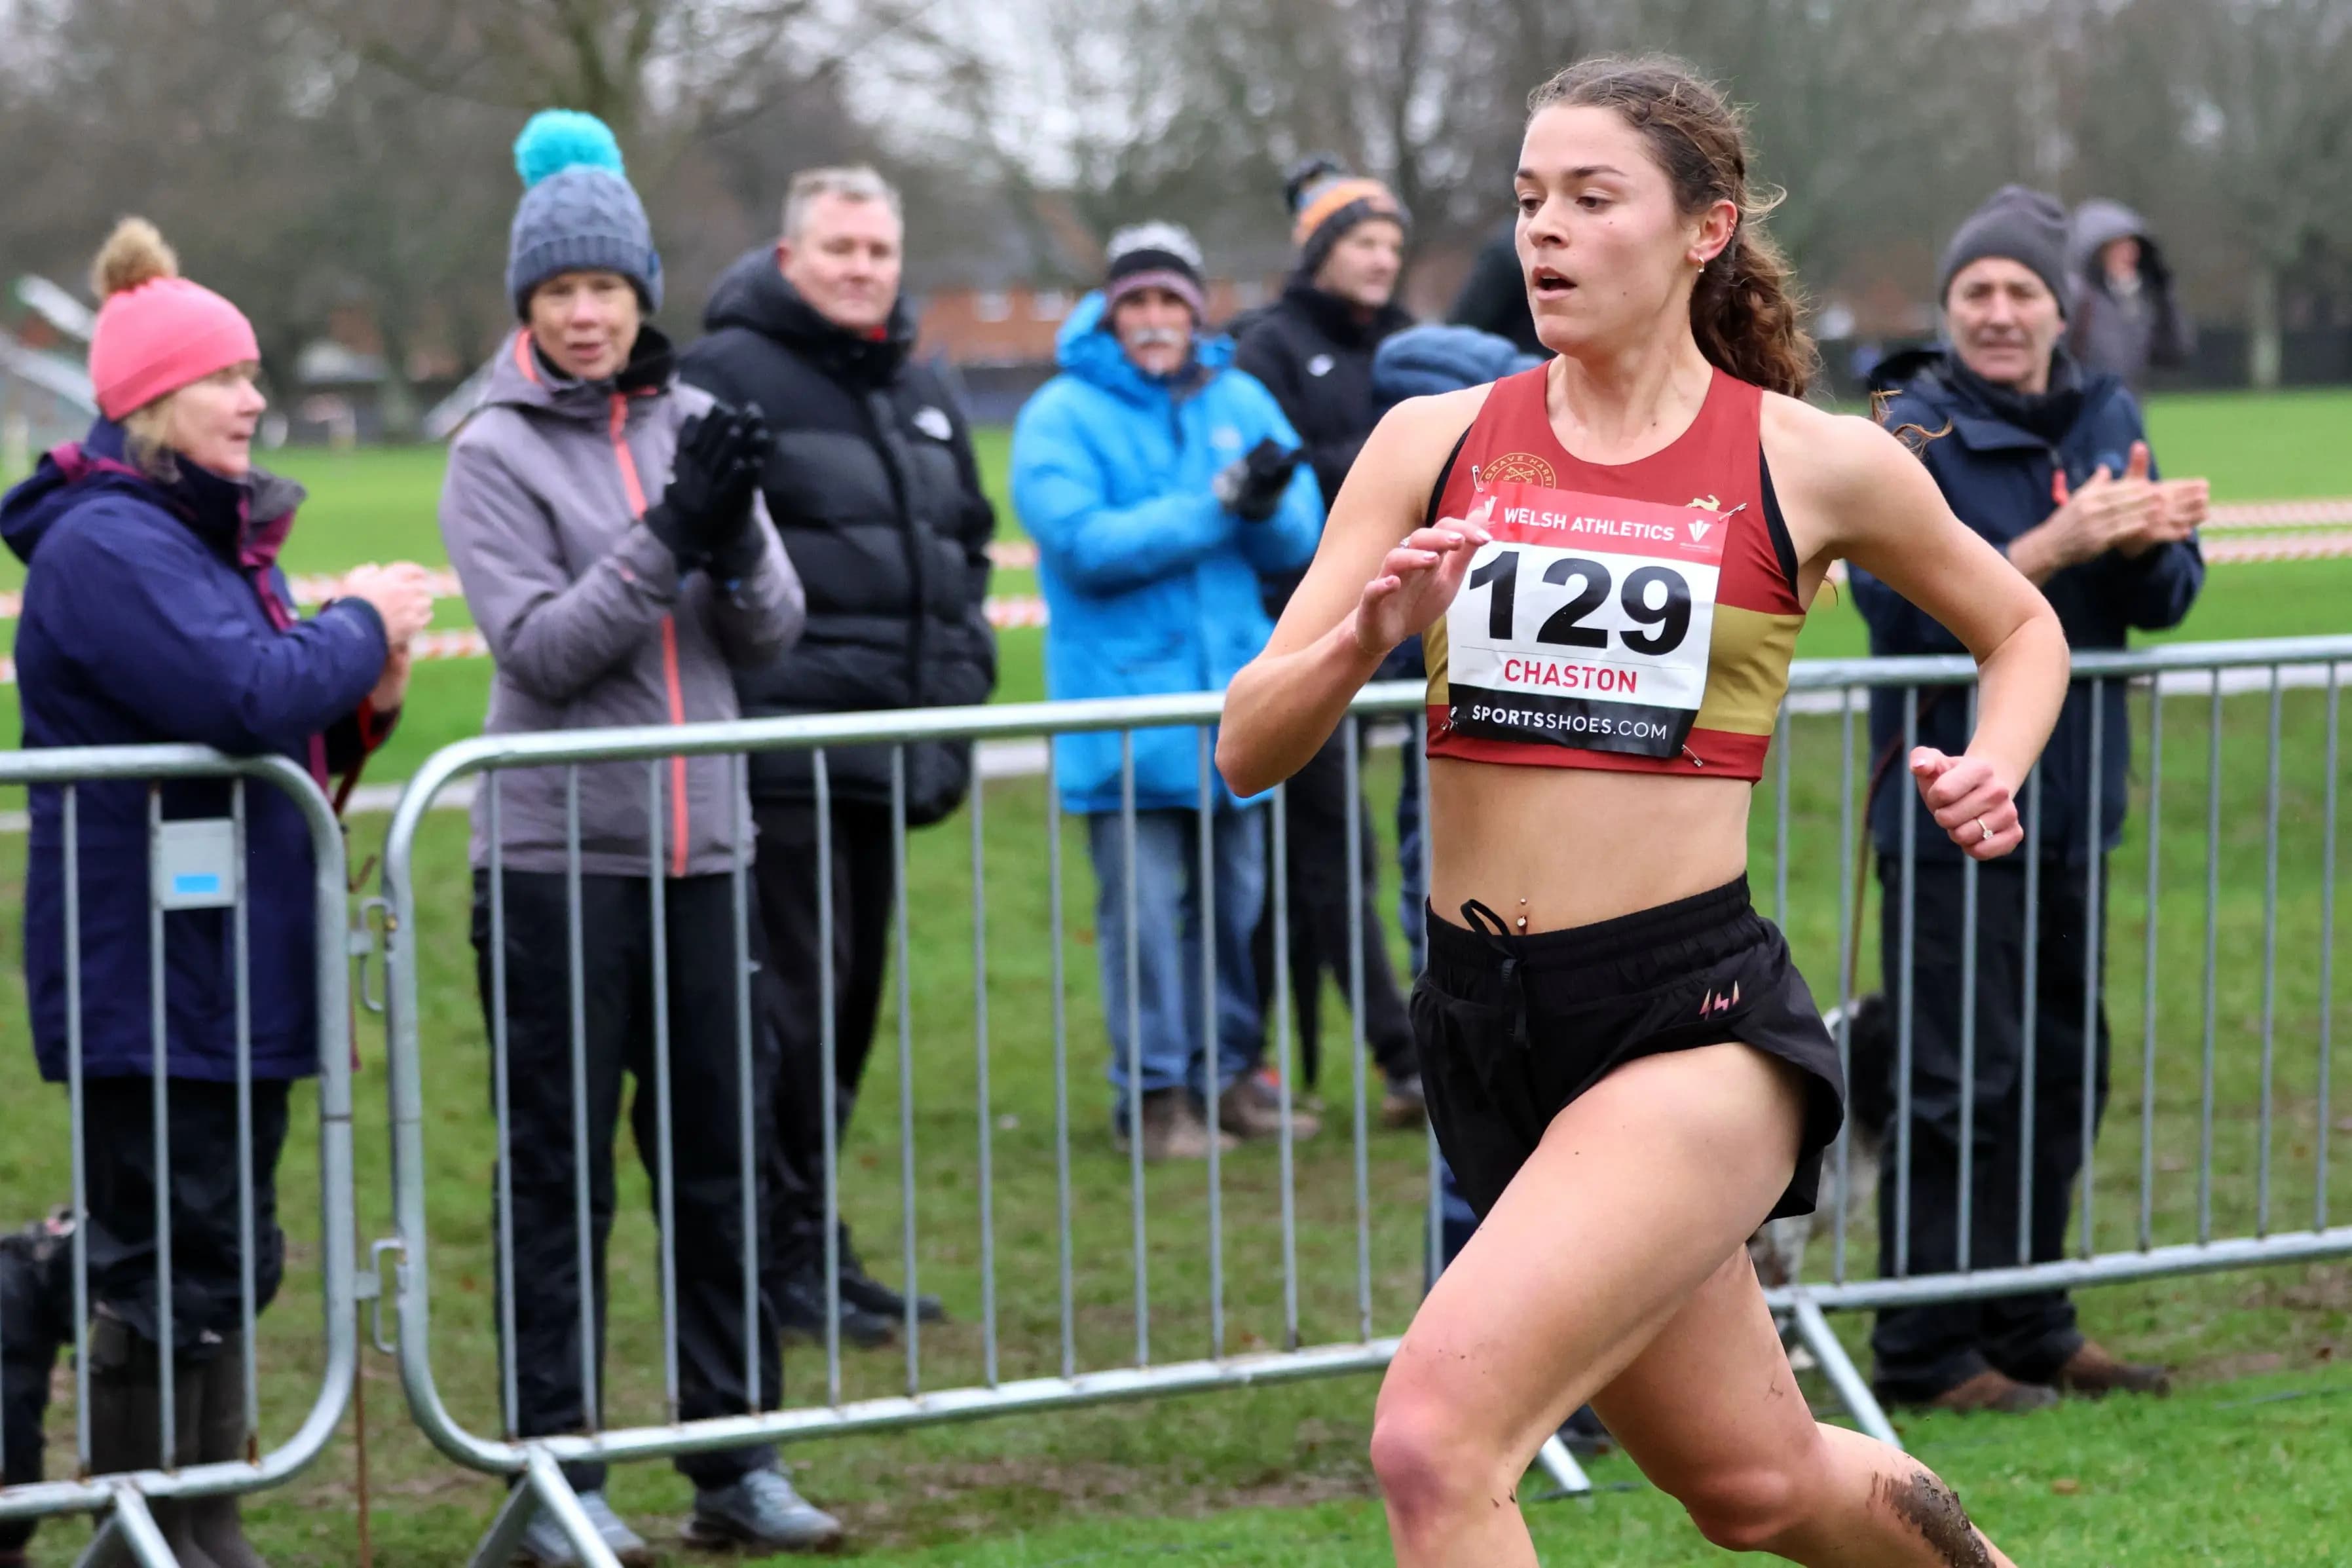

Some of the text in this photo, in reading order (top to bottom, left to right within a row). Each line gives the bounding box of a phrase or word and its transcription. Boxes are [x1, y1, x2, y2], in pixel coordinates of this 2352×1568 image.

[1483, 455, 1525, 481] GRAVE
[1504, 507, 1675, 541] WELSH ATHLETICS
[1469, 550, 1692, 656] 129
[1504, 659, 1637, 694] CHASTON
[1472, 705, 1668, 740] SPORTSSHOES.COM
